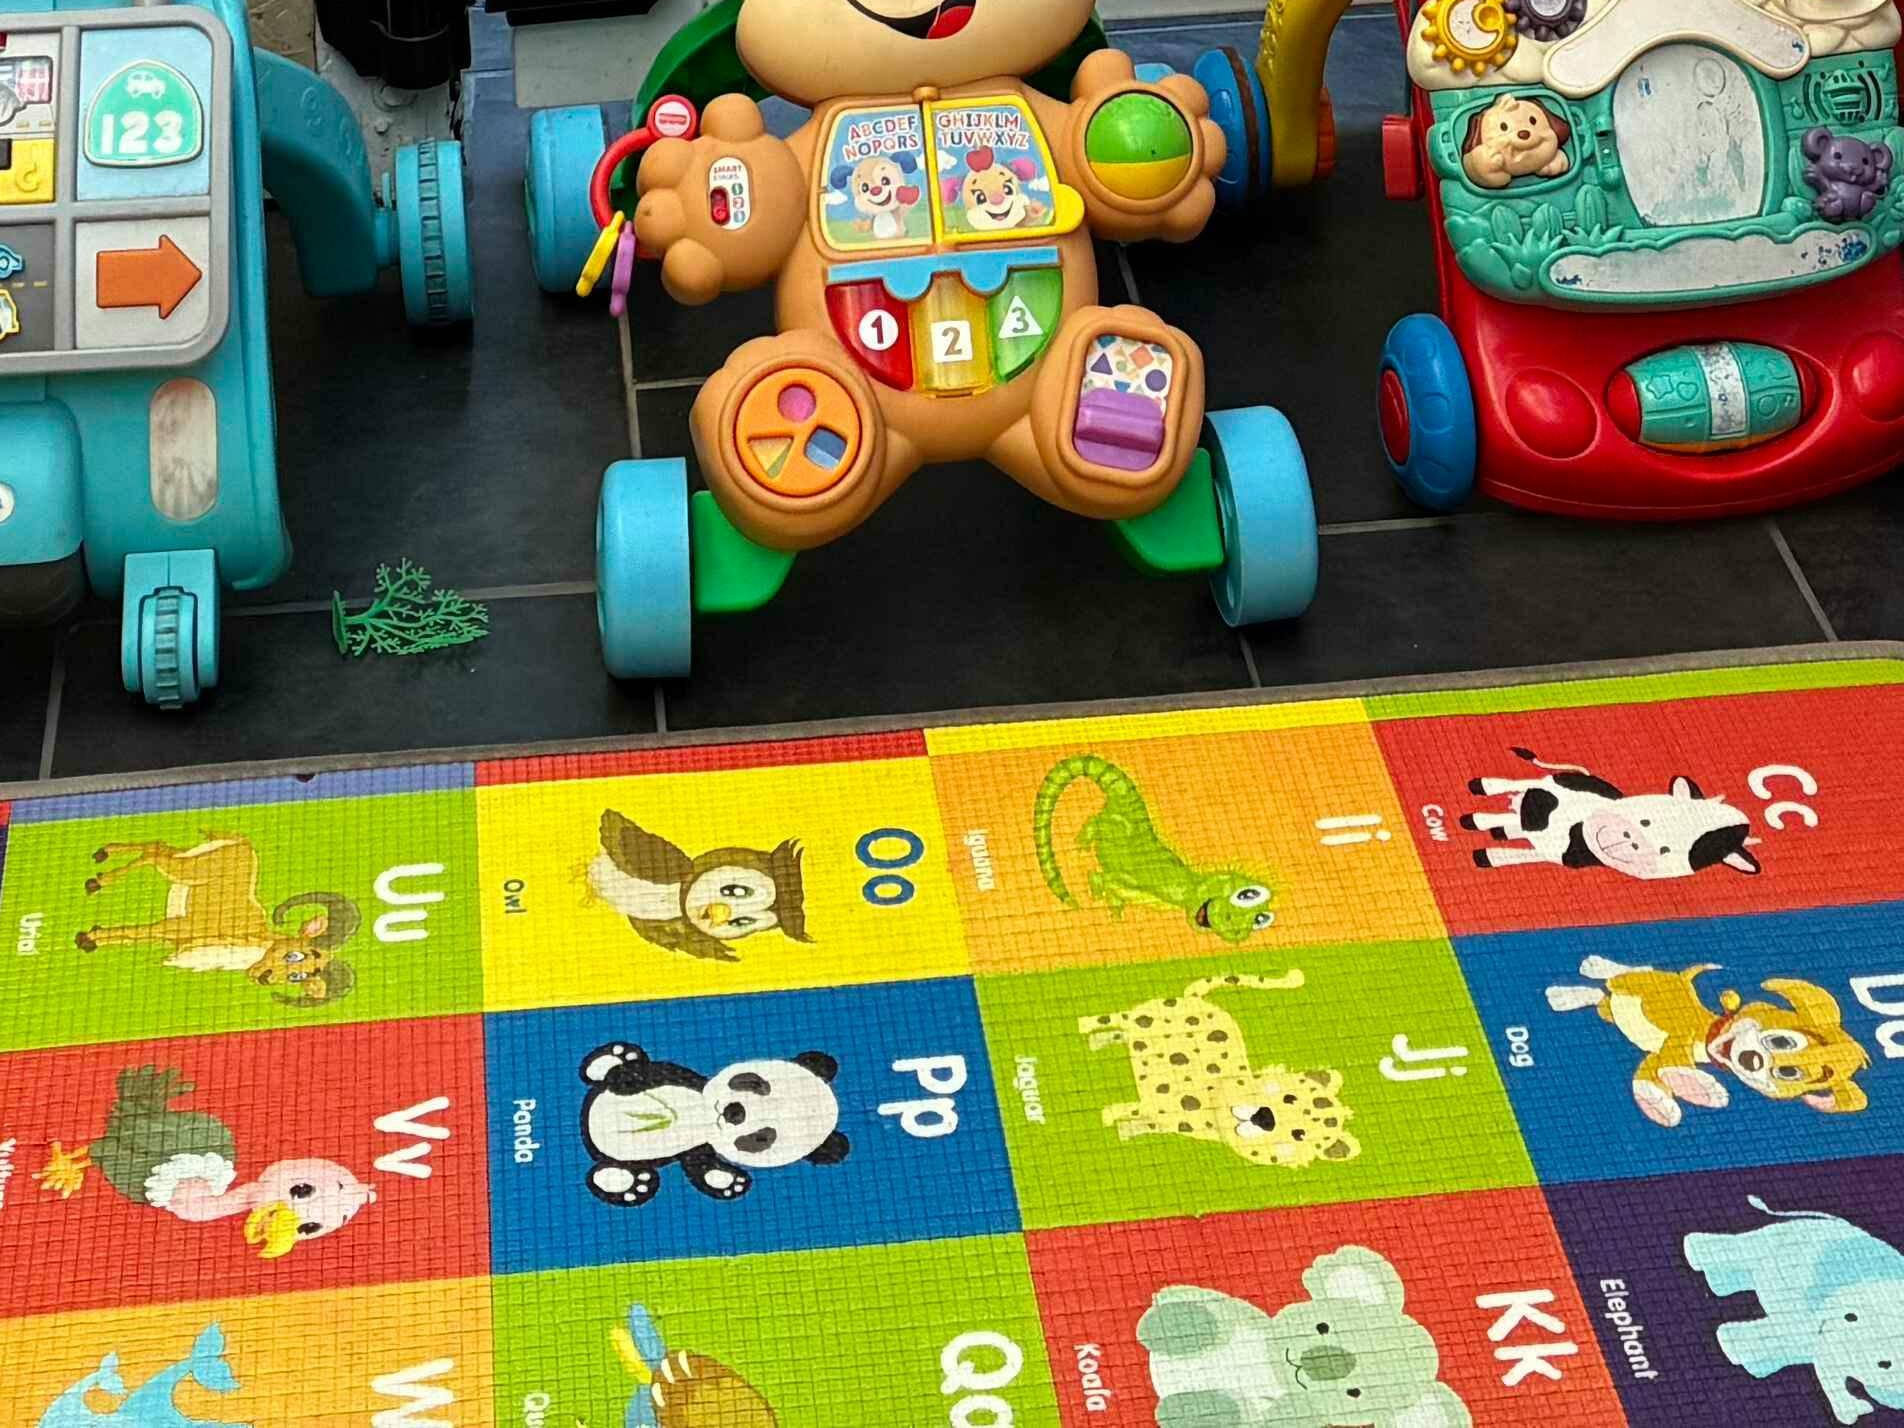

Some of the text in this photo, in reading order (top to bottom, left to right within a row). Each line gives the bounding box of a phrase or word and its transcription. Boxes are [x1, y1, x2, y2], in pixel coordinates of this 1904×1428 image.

[100, 110, 183, 155] 123
[850, 116, 916, 140] ABCDEF
[939, 113, 1019, 129] GHIJKLM
[940, 132, 1029, 147] TUVWXYZ
[845, 134, 918, 159] NOPQRS
[15, 162, 41, 193] C
[871, 307, 1029, 356] 1 2 3
[503, 879, 526, 914] Owl
[1505, 1026, 1535, 1069] Dog
[1013, 1054, 1046, 1125] Jaguar
[512, 1098, 542, 1165] Panda
[1600, 1277, 1659, 1381] Elephant
[1073, 1343, 1112, 1412] Koala
